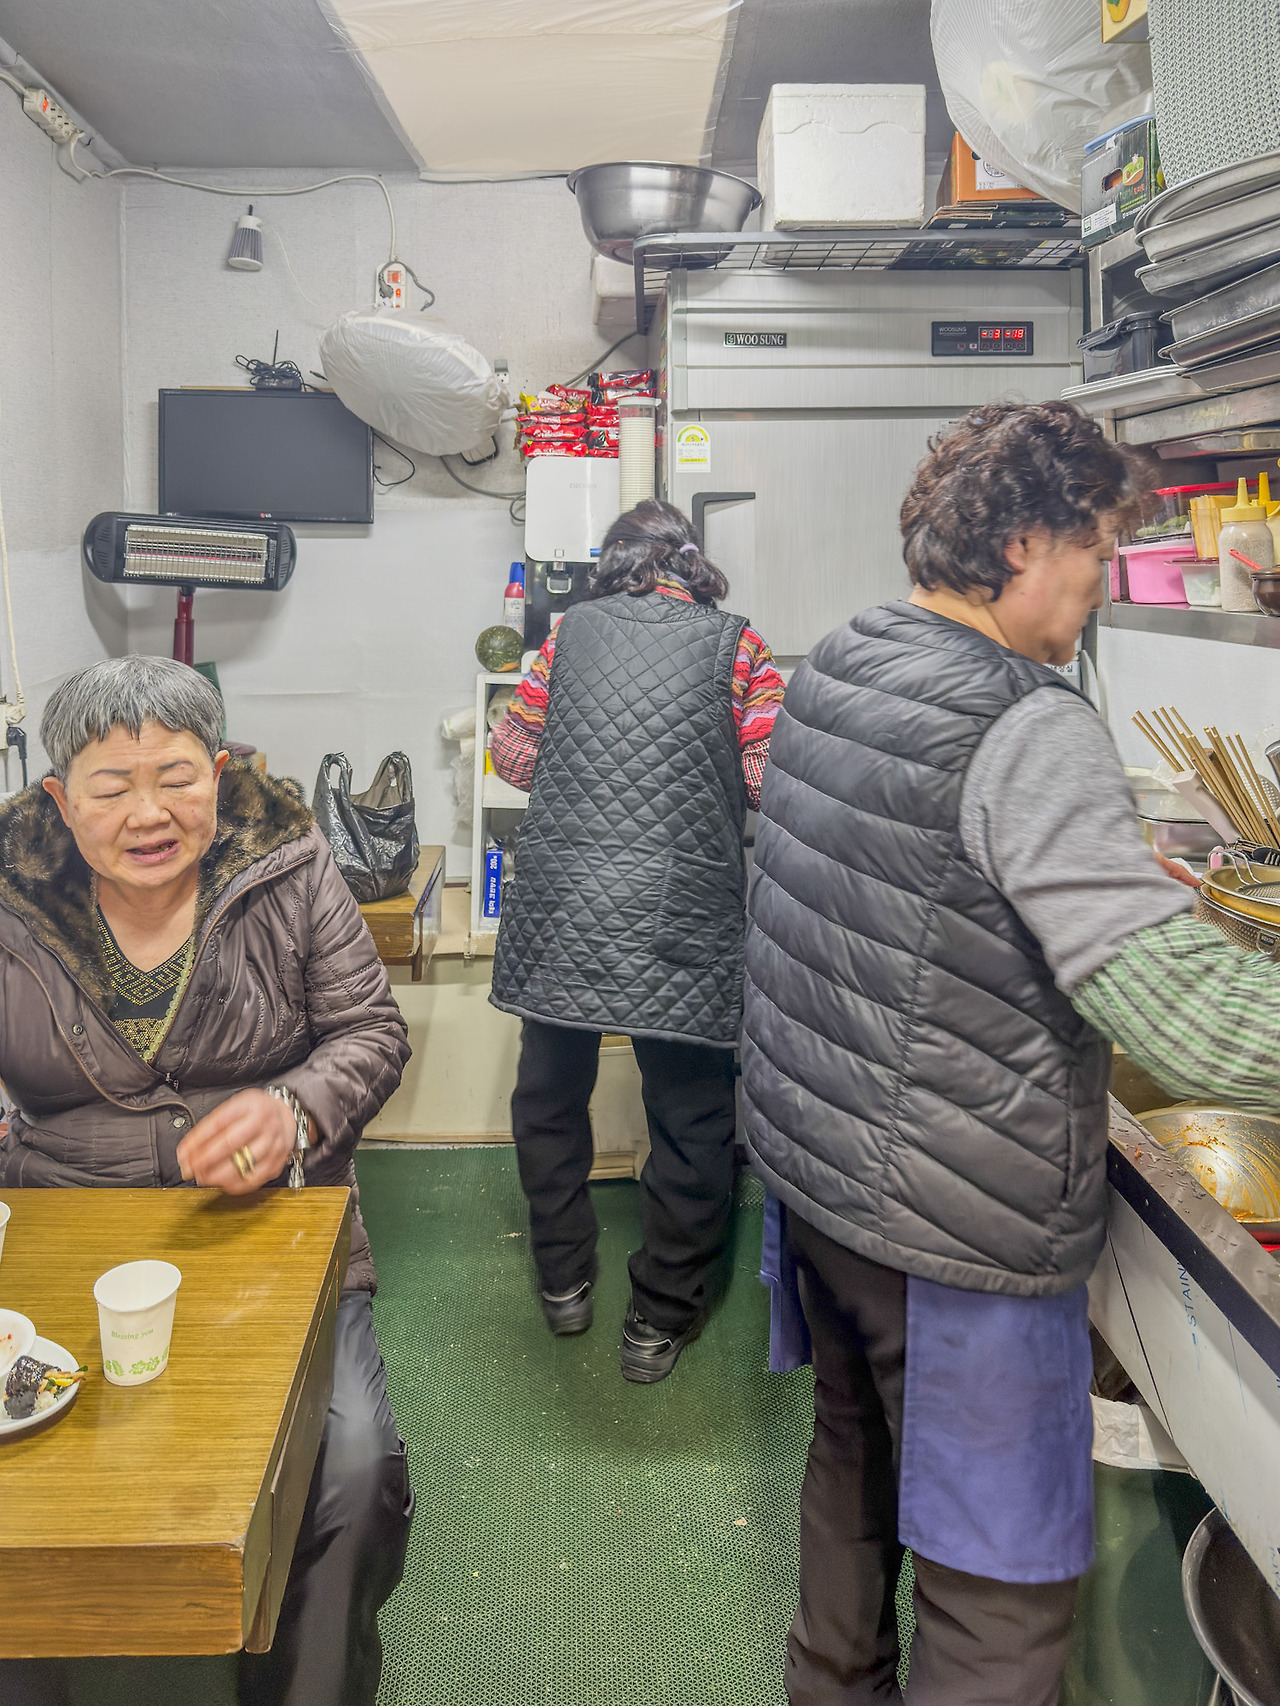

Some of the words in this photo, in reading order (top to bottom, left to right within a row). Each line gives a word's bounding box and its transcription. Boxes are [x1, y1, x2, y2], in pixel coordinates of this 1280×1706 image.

[736, 334, 758, 345] WOO
[759, 334, 784, 345] SUNG
[1177, 1261, 1197, 1327] STAIN
[111, 1330, 139, 1340] Blessing
[140, 1328, 154, 1338] you
